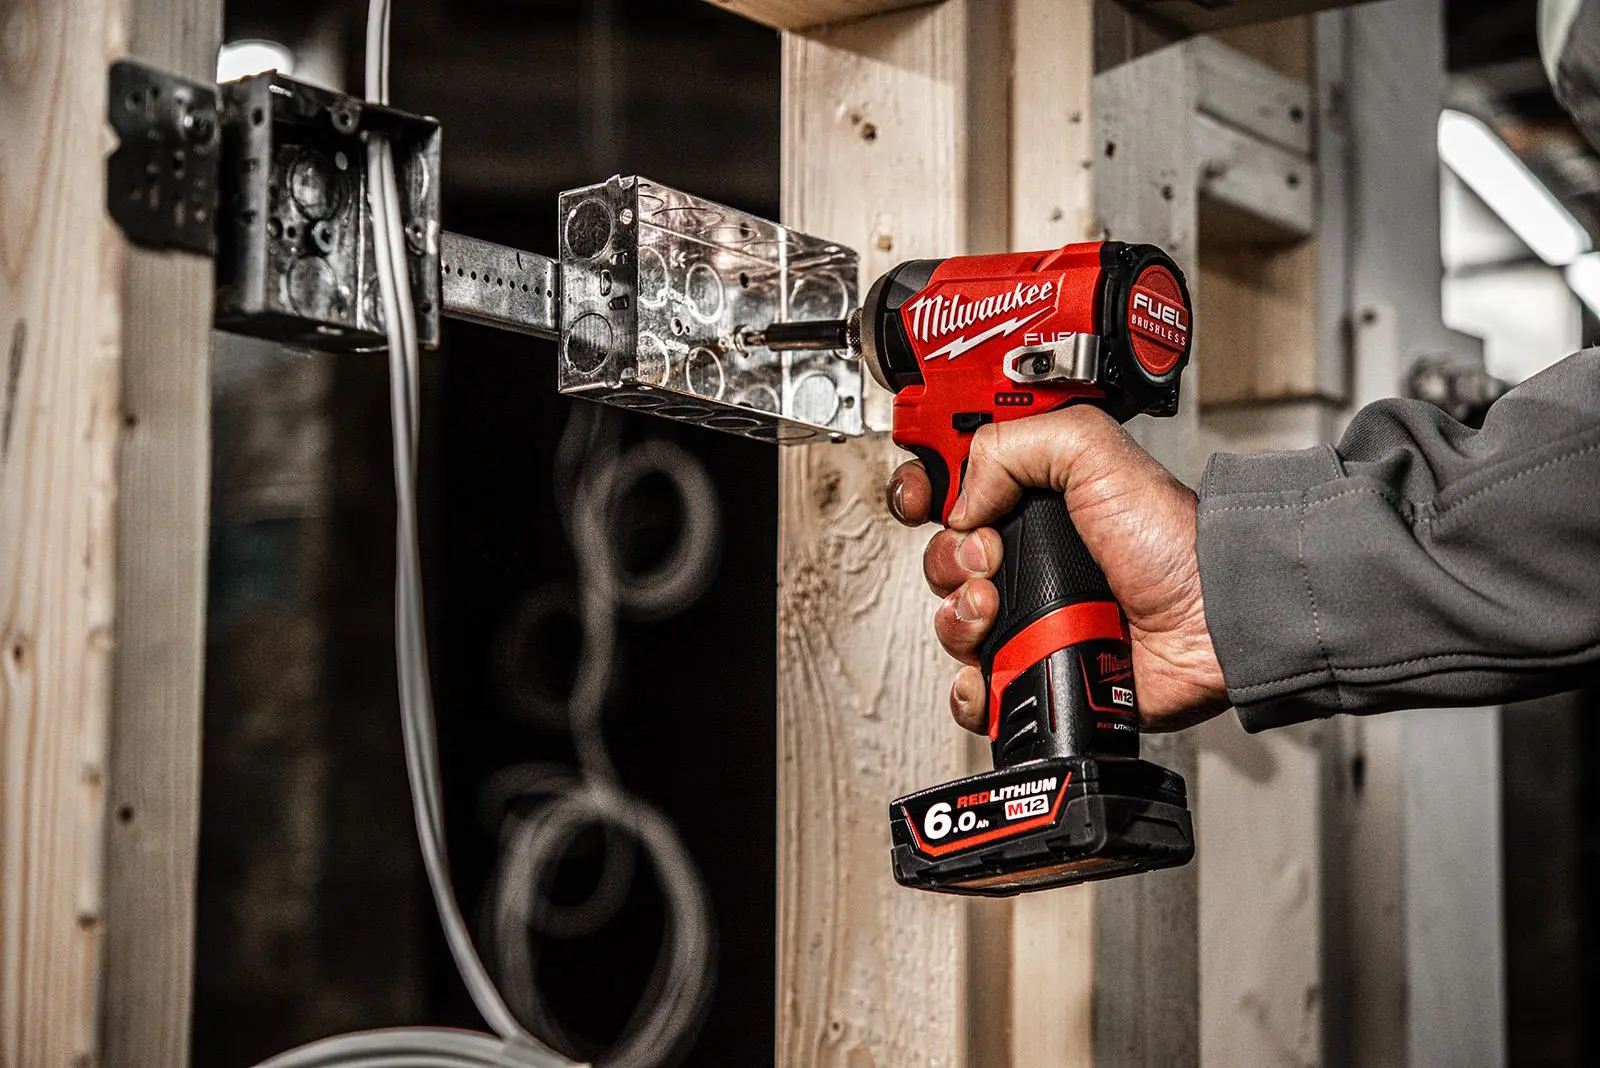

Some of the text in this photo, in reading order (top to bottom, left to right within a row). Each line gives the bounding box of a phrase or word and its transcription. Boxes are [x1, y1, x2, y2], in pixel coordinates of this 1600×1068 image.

[908, 281, 1053, 343] Milwaukee
[1133, 293, 1187, 331] FUEL
[1024, 331, 1076, 346] FUE
[1131, 314, 1186, 346] BRUSHLESS
[1113, 688, 1133, 703] M12
[957, 777, 1057, 808] REDLITHIUM
[1007, 798, 1045, 817] M12
